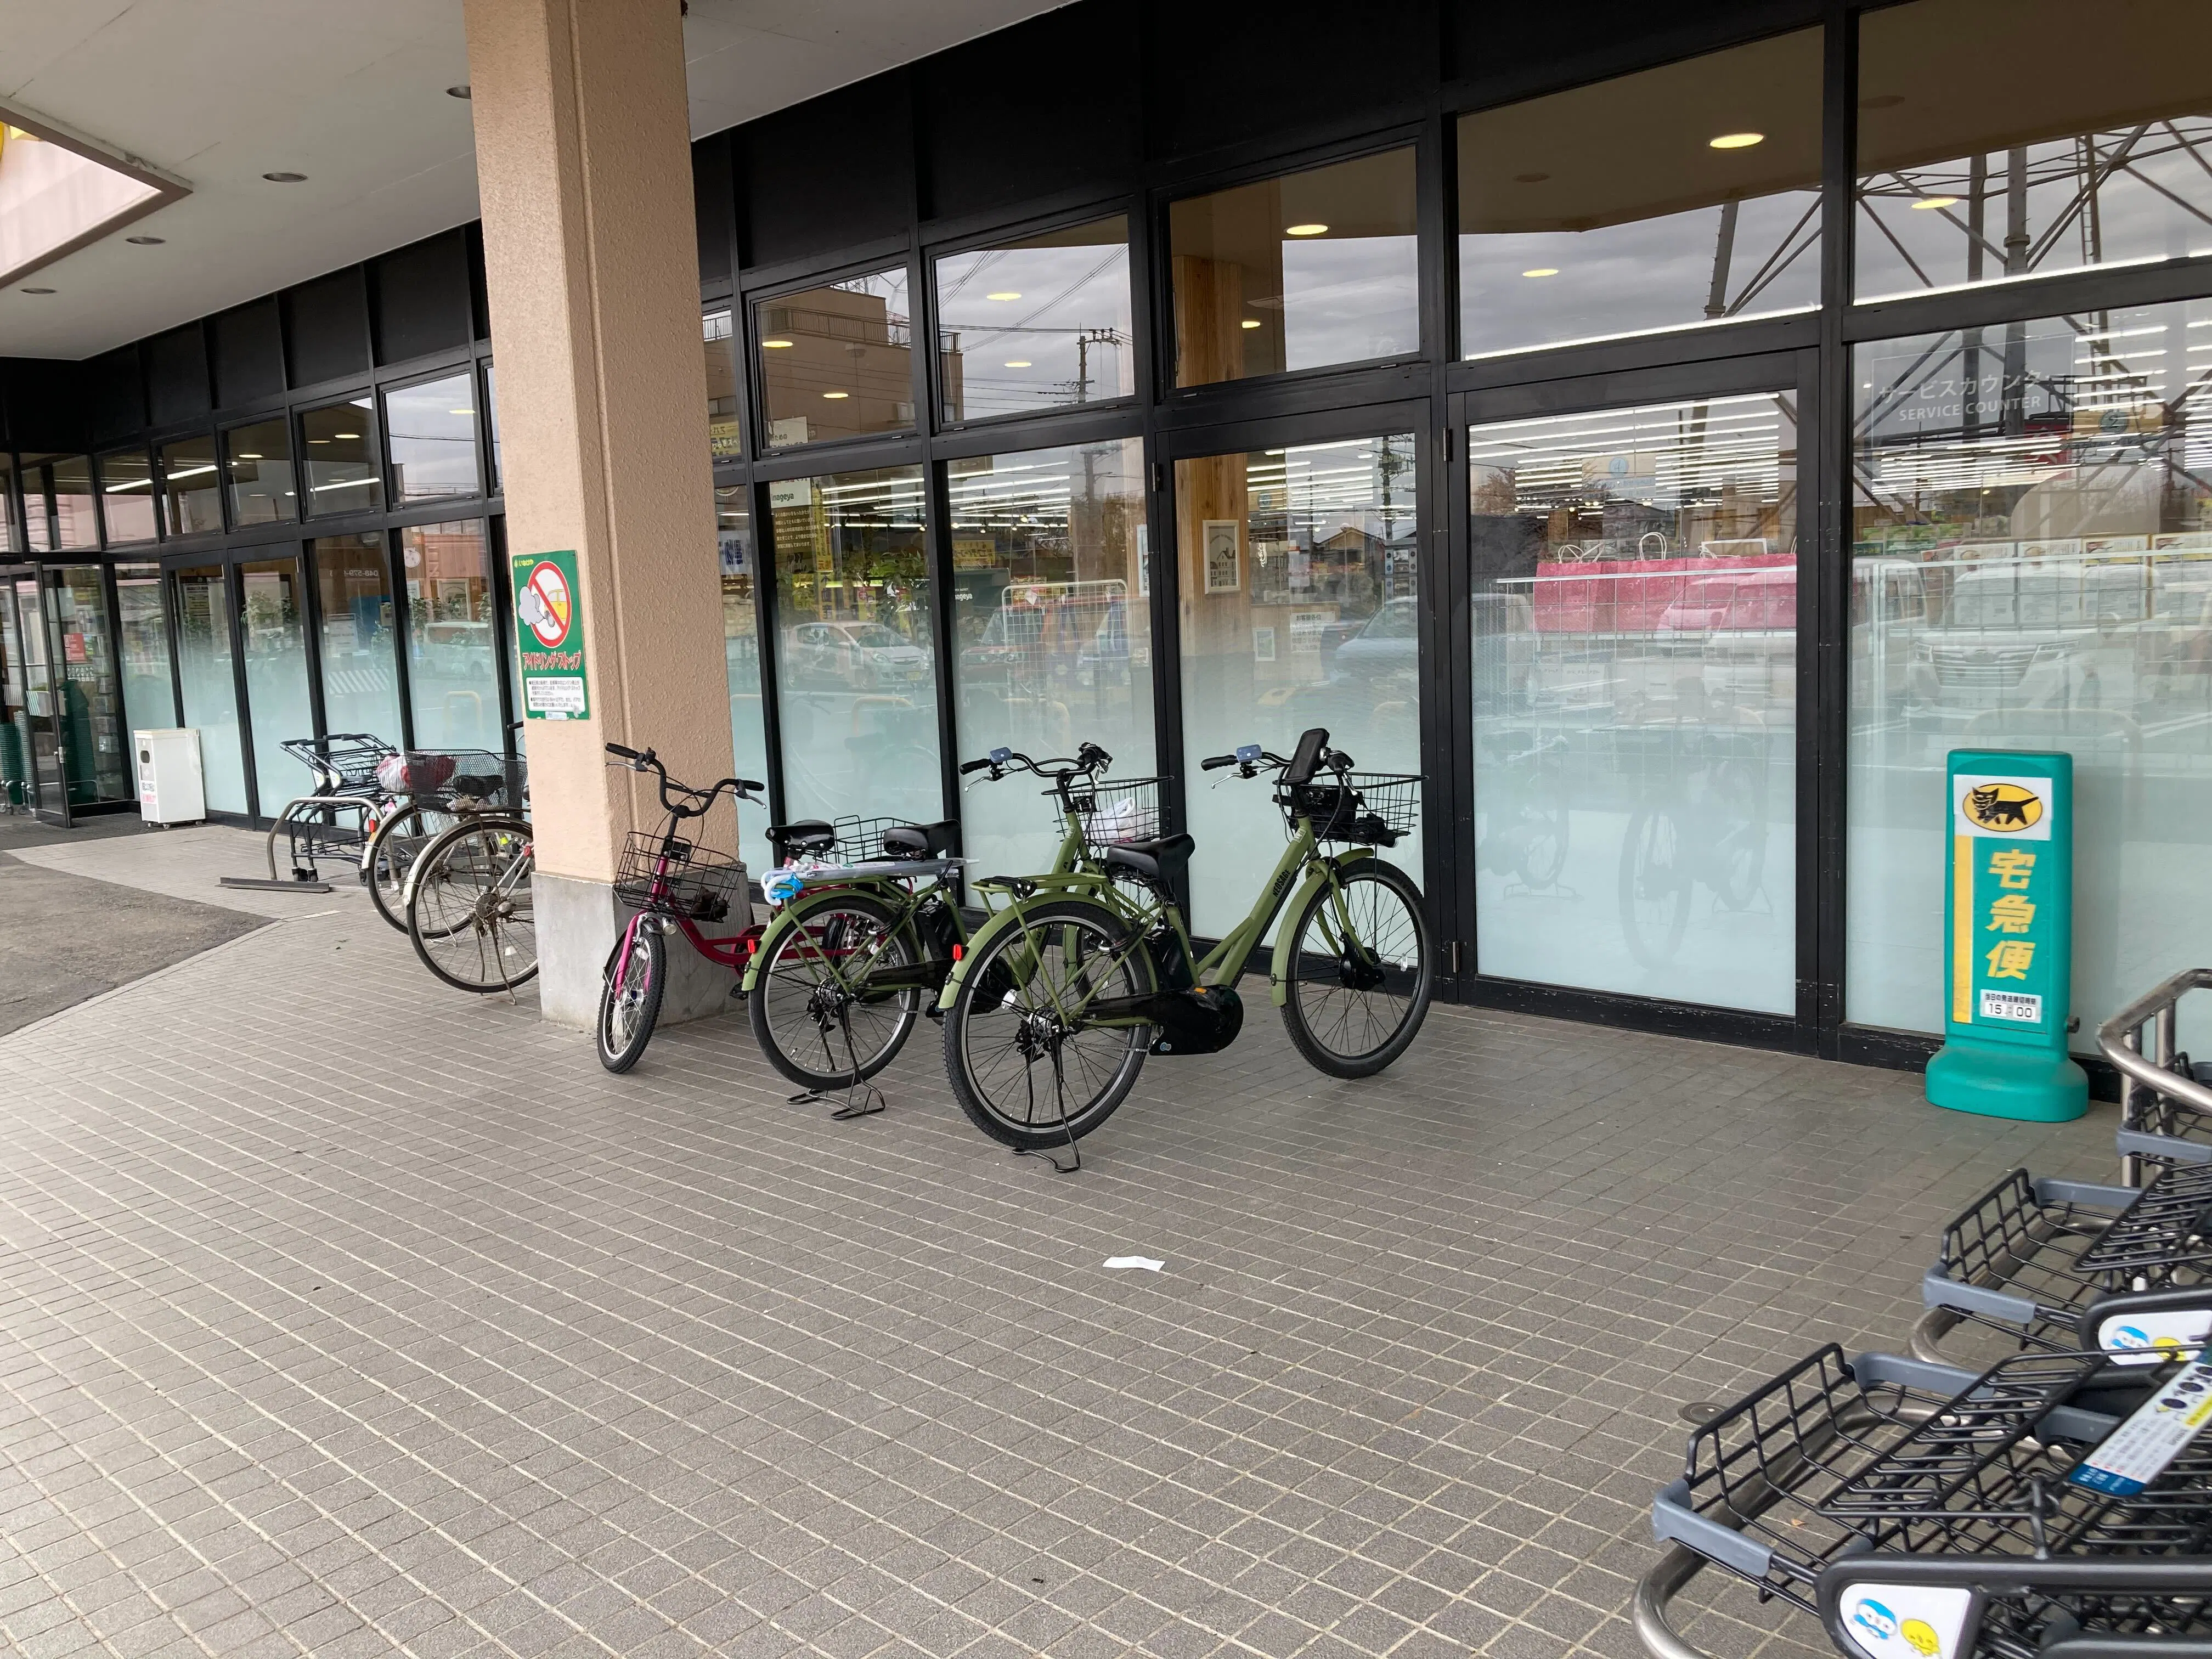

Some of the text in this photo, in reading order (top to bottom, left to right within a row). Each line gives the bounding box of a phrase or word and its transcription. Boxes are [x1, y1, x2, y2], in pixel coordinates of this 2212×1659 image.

[1899, 396, 2041, 421] SERVICE COUNTER
[1273, 868, 1291, 898] NEOSAGE
[1984, 849, 2036, 981] 宅急便
